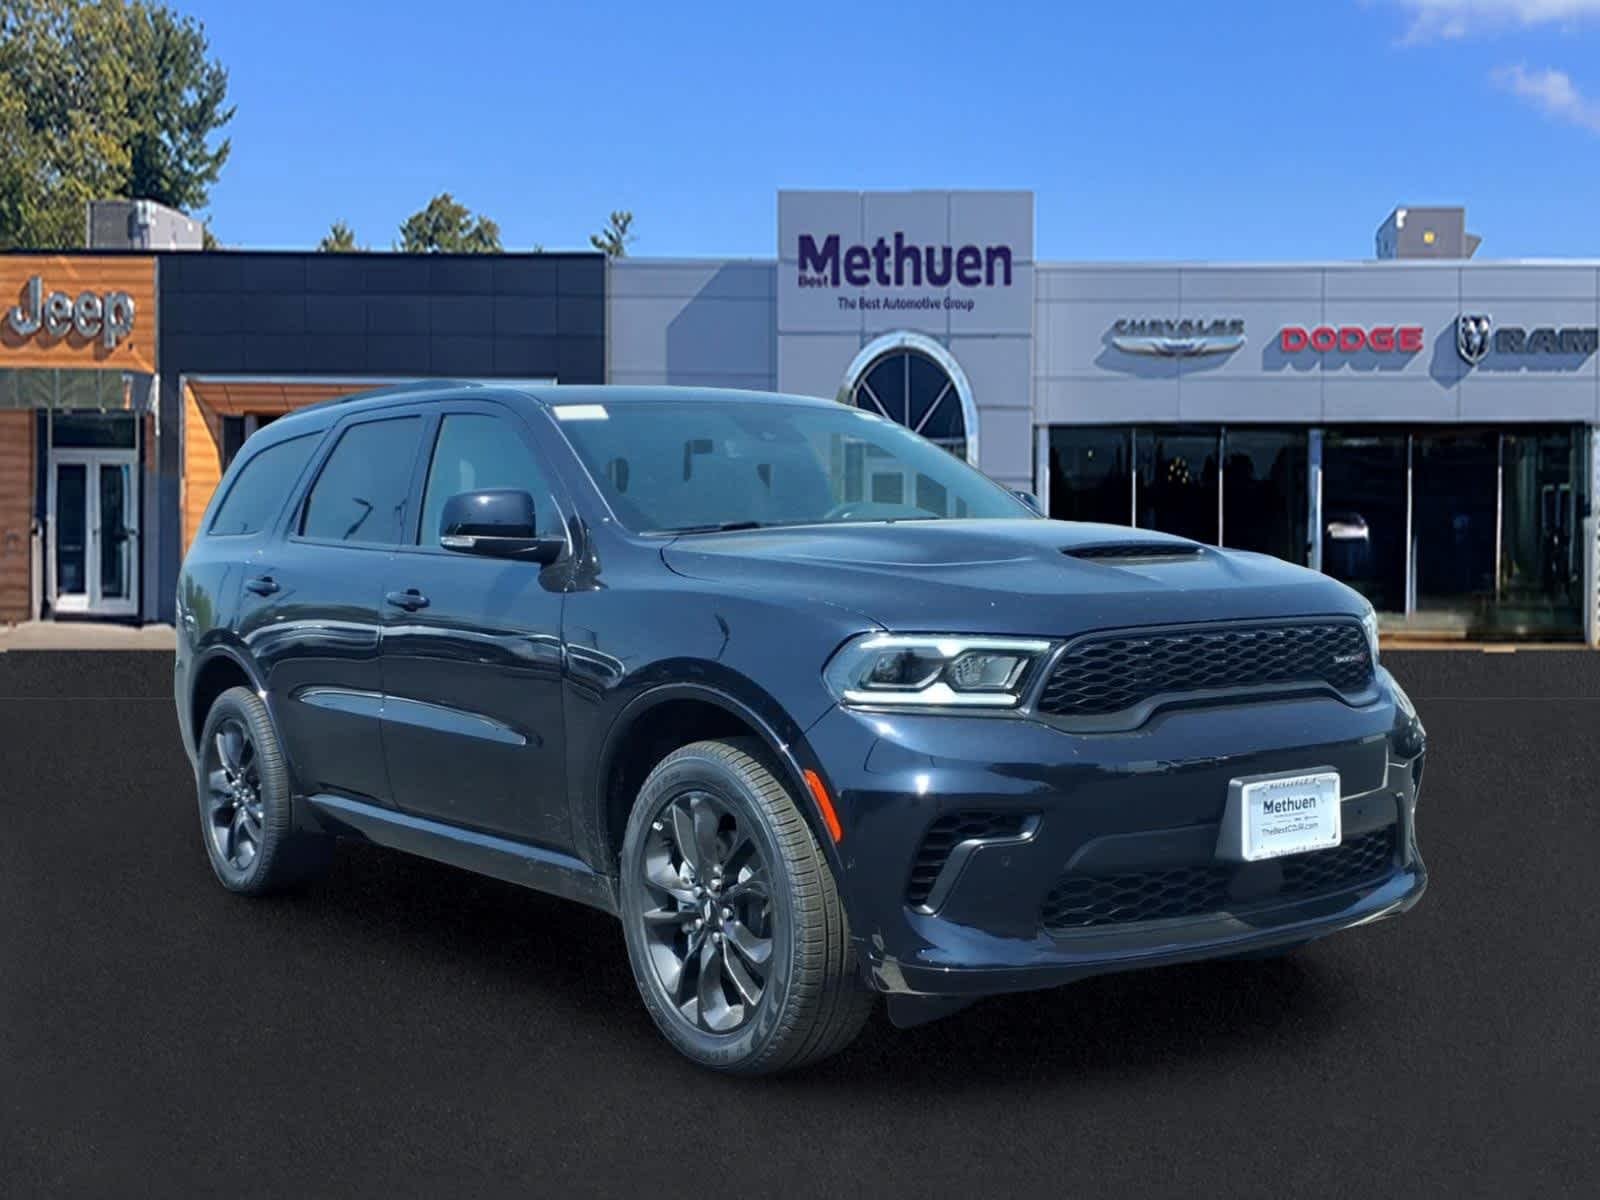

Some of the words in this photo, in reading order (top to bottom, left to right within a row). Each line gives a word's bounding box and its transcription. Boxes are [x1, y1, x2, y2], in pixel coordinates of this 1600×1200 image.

[798, 232, 1012, 287] Methuen
[798, 274, 829, 288] Best
[9, 275, 135, 348] Jeep
[838, 297, 857, 309] The
[859, 297, 880, 309] Best
[883, 297, 941, 310] Automotive
[943, 297, 975, 311] Group
[1113, 318, 1245, 336] CHRYSLER
[1281, 326, 1424, 352] DODGE
[1495, 327, 1598, 353] RAM
[1263, 797, 1316, 815] Methuen
